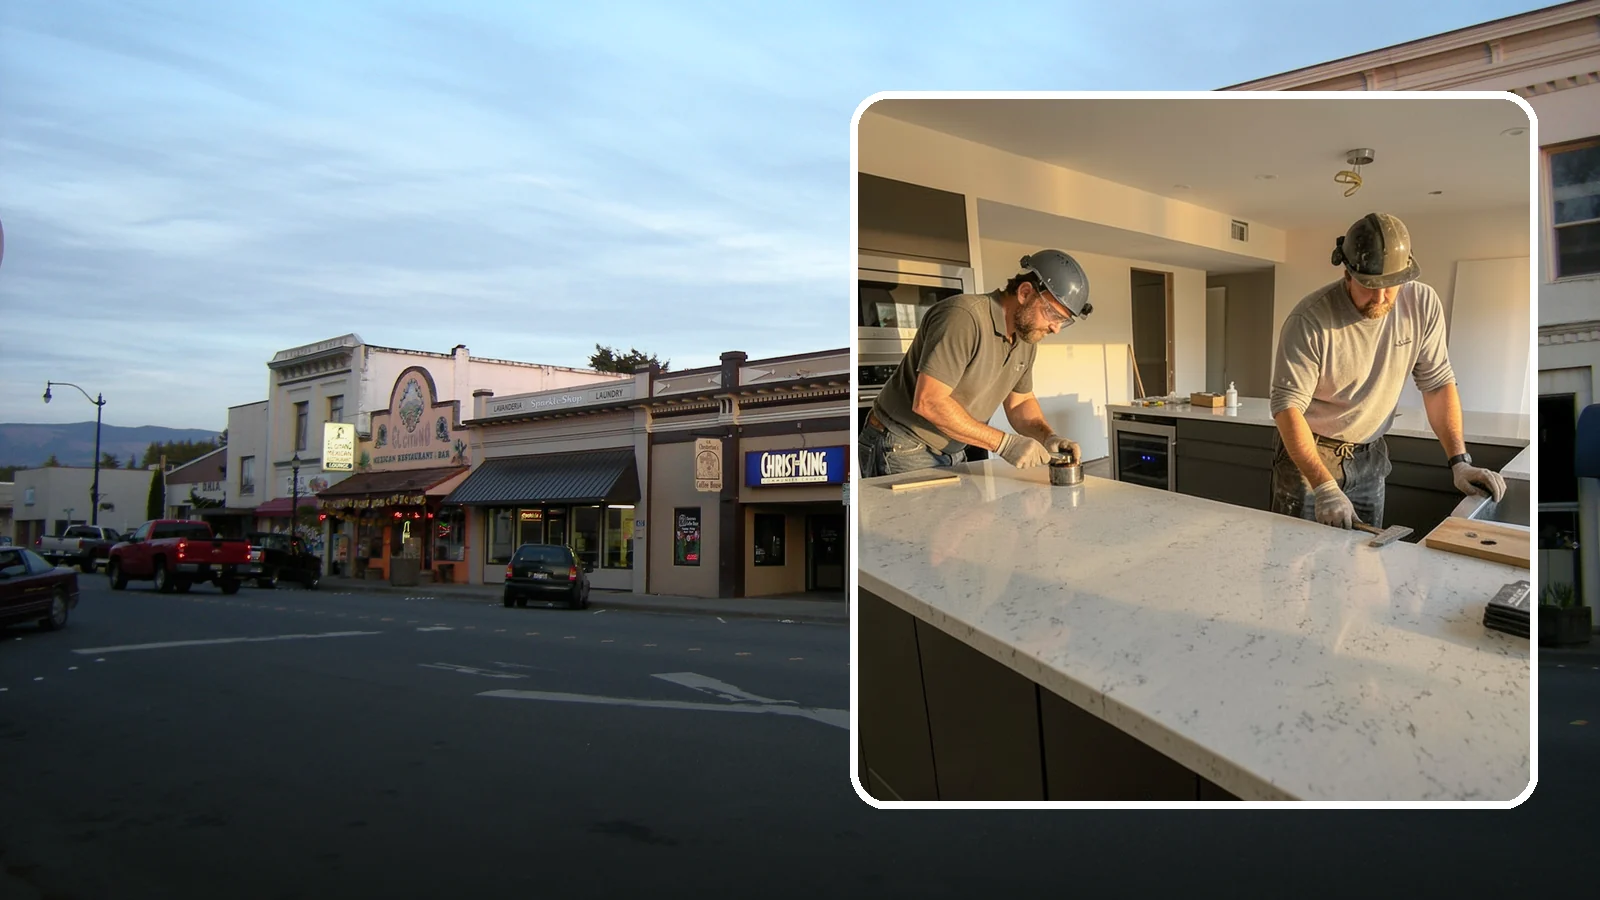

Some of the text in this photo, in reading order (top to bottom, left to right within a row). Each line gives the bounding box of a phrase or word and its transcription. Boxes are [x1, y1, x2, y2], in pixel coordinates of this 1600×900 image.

[493, 402, 523, 412] LAVANDERIA
[562, 394, 583, 404] Shop
[596, 389, 624, 400] LAUNDRY
[373, 454, 396, 464] MEXICAN
[397, 451, 433, 462] RESTAURANT
[438, 449, 450, 459] BAR
[761, 450, 827, 478] CHRIST KING
